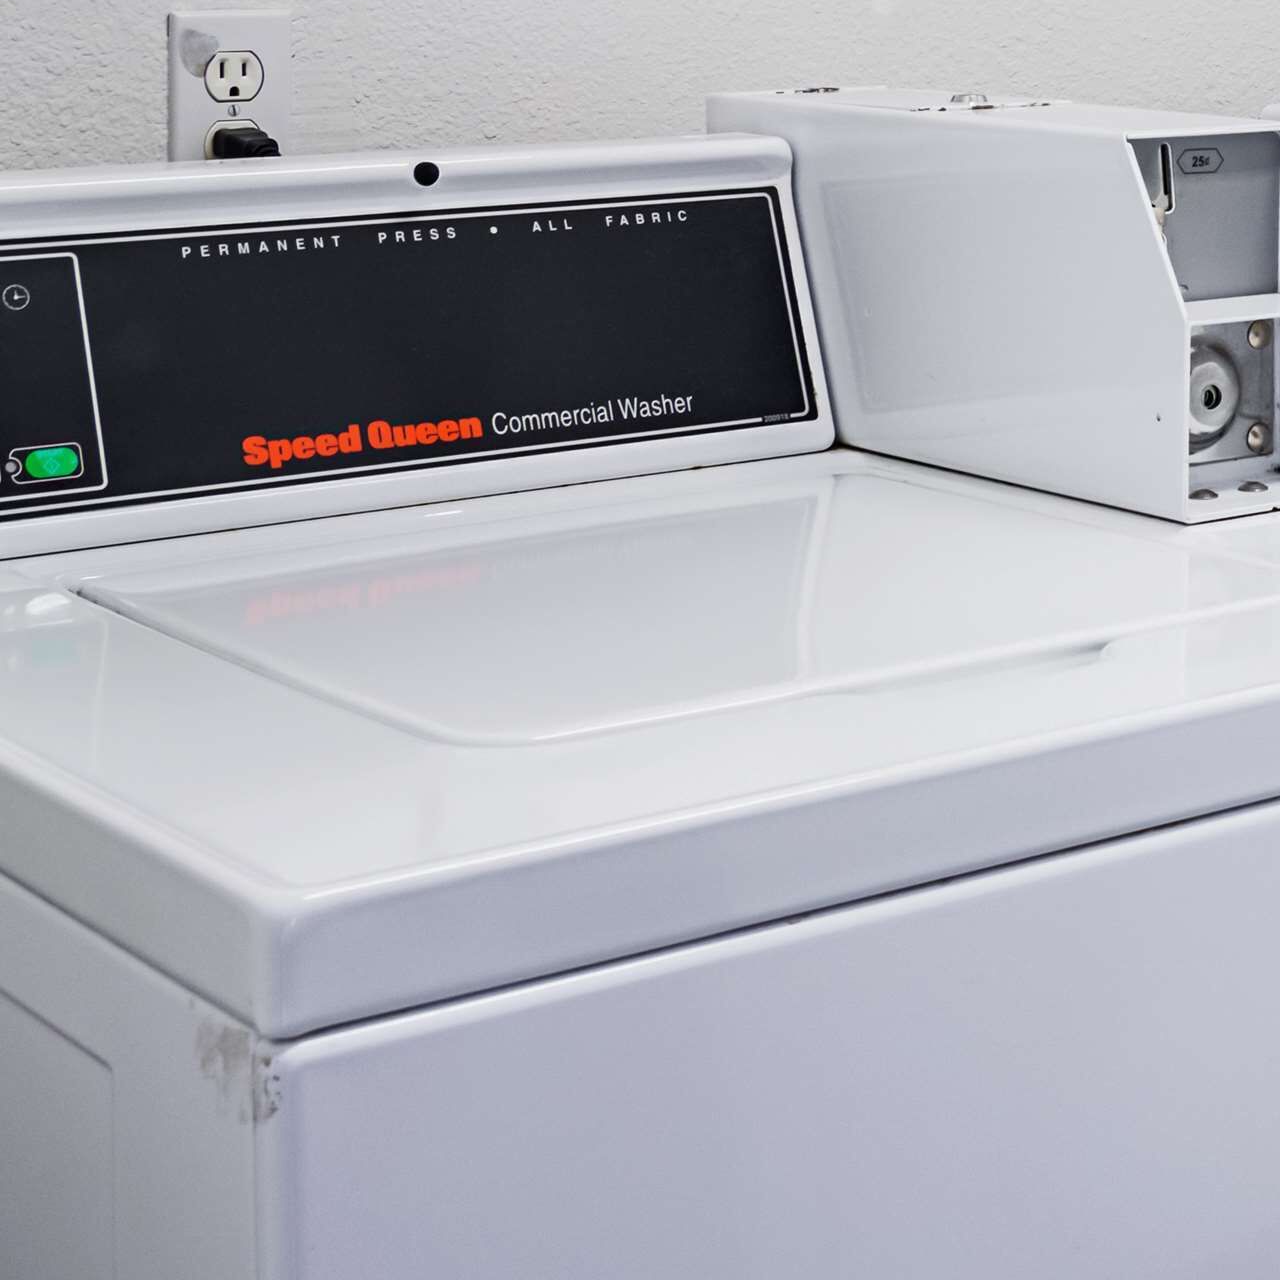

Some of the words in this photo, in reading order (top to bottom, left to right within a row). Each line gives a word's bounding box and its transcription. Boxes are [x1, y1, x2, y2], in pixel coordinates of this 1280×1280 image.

[182, 235, 339, 257] PERMANENT
[378, 227, 455, 243] PRESS
[532, 219, 572, 231] ALL
[605, 210, 686, 226] FABRIC
[242, 425, 361, 467] Speed
[367, 418, 482, 448] Queen
[492, 400, 613, 434] Commercial
[617, 394, 692, 418] Washer
